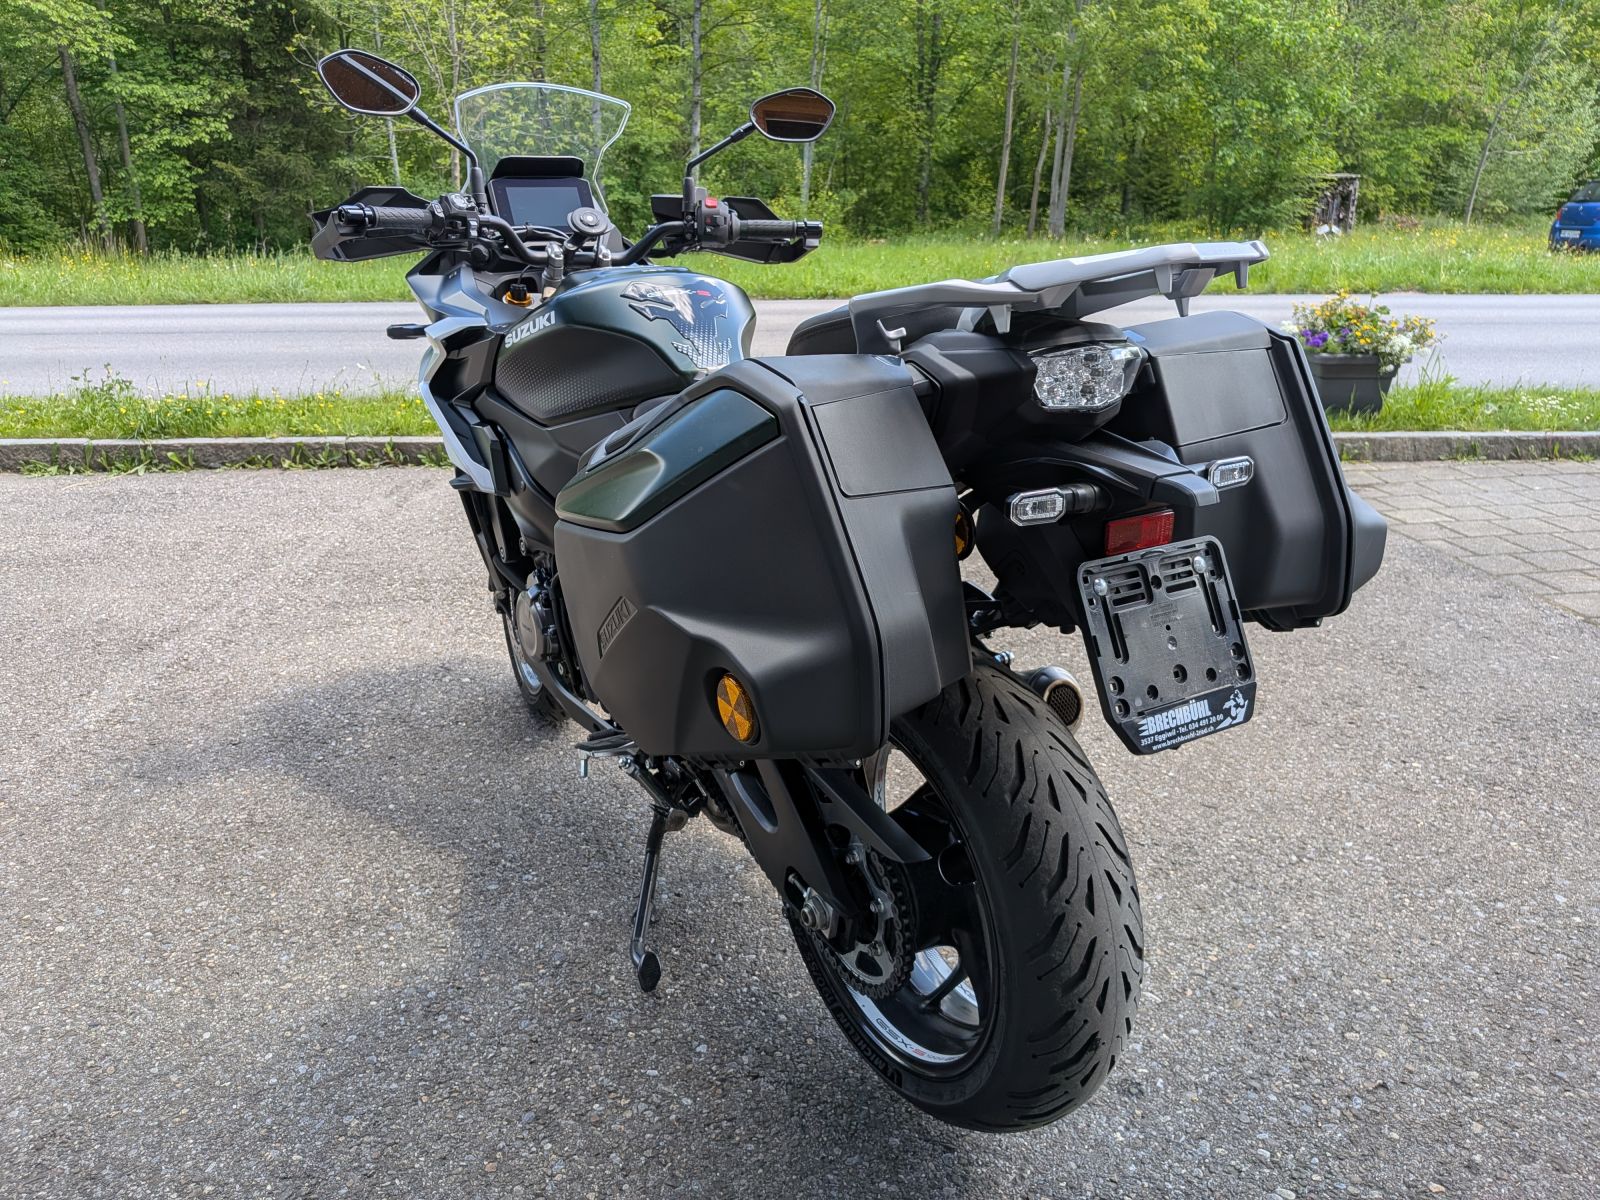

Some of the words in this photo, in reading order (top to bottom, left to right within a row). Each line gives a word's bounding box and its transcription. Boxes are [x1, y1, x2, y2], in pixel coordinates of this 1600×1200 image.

[504, 310, 556, 349] SUZUKI
[1141, 737, 1154, 746] 3537
[1155, 729, 1176, 742] Eggiwil
[1179, 724, 1189, 734] Tel.
[1188, 721, 1199, 730] 034
[1147, 699, 1212, 735] BRECHBÜHL
[835, 1010, 887, 1070] MICHELIN
